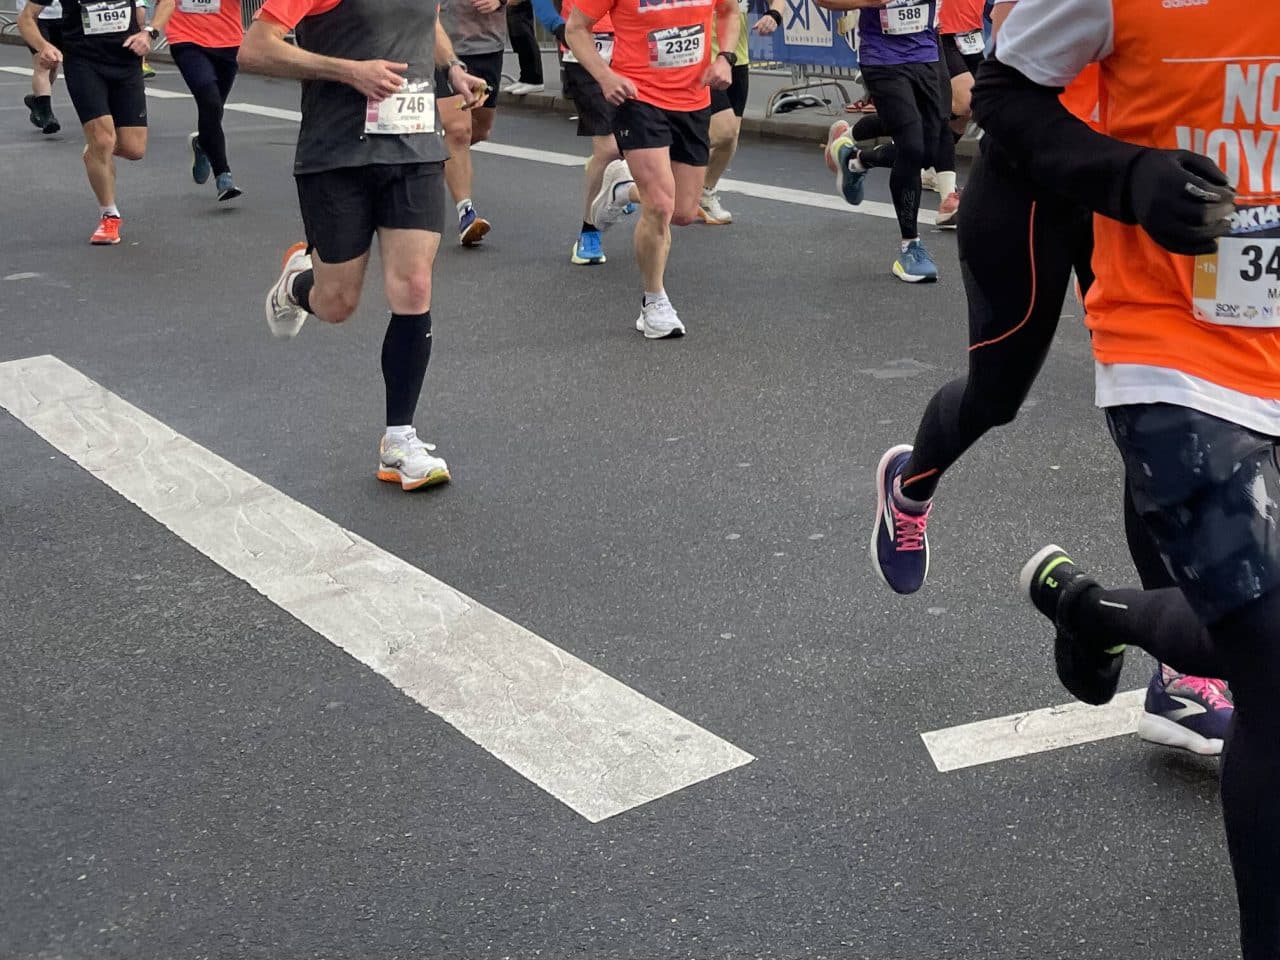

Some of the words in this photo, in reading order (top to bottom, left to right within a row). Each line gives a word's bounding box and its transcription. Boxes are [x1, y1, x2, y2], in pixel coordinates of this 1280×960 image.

[95, 9, 127, 23] 1694
[897, 7, 922, 21] 588
[665, 37, 701, 55] 2329
[395, 96, 426, 114] 746
